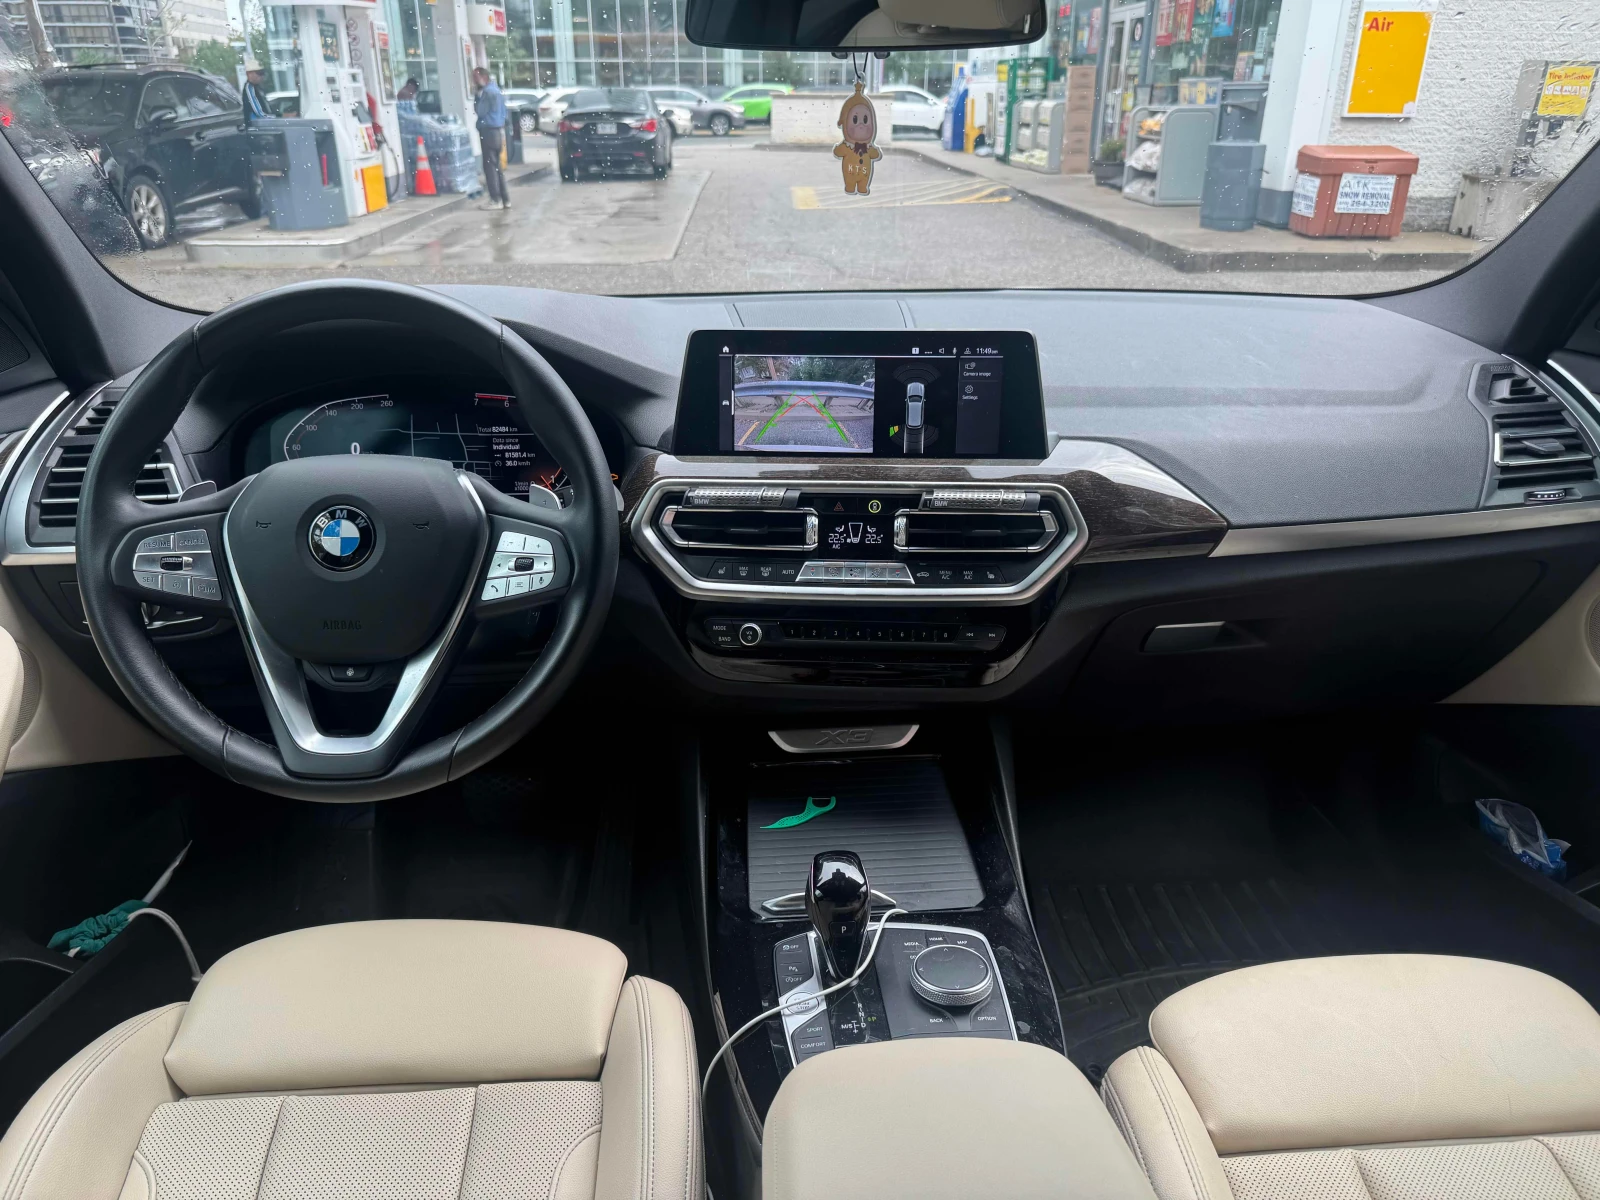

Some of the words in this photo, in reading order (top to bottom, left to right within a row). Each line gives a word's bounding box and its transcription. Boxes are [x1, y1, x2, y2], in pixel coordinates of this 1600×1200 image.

[1367, 17, 1394, 32] Air
[1549, 72, 1562, 80] Tire
[848, 164, 867, 175] KTS
[1339, 191, 1360, 200] SNOW
[1361, 191, 1390, 200] REMOVAL
[474, 398, 479, 406] 7
[504, 400, 510, 408] 6
[325, 409, 338, 417] 140
[350, 442, 361, 455] 0
[317, 509, 368, 529] BMW
[144, 541, 171, 549] RESUME
[322, 620, 363, 630] AIRBAG
[815, 728, 874, 745] X3
[841, 925, 847, 934] P
[800, 1041, 826, 1049] COMFORT
